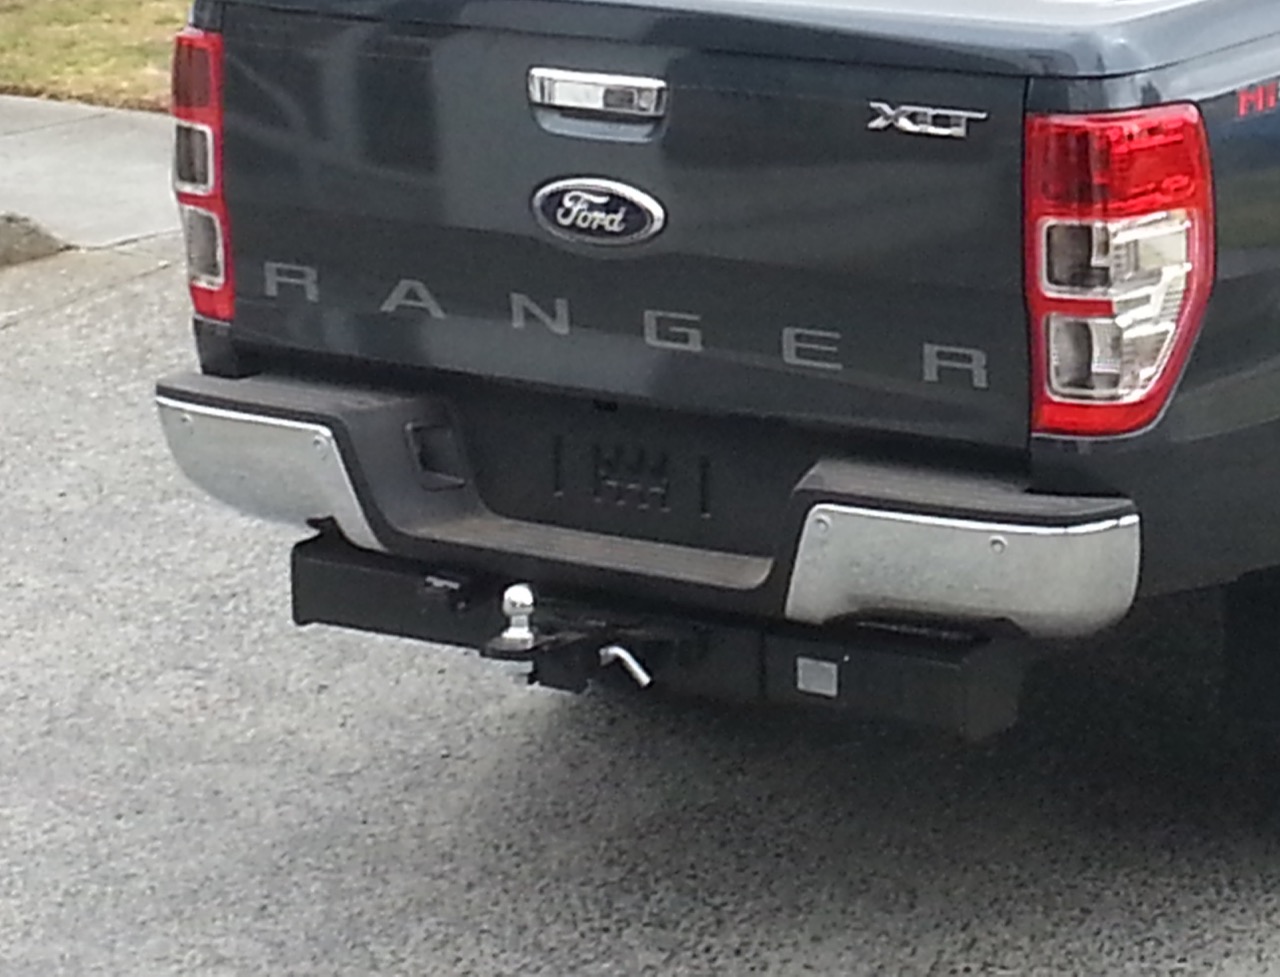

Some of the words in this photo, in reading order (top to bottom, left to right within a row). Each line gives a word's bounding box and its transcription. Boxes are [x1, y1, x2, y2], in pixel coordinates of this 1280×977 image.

[867, 101, 988, 138] XLT
[556, 190, 627, 233] Ford
[264, 261, 989, 389] RANGER
